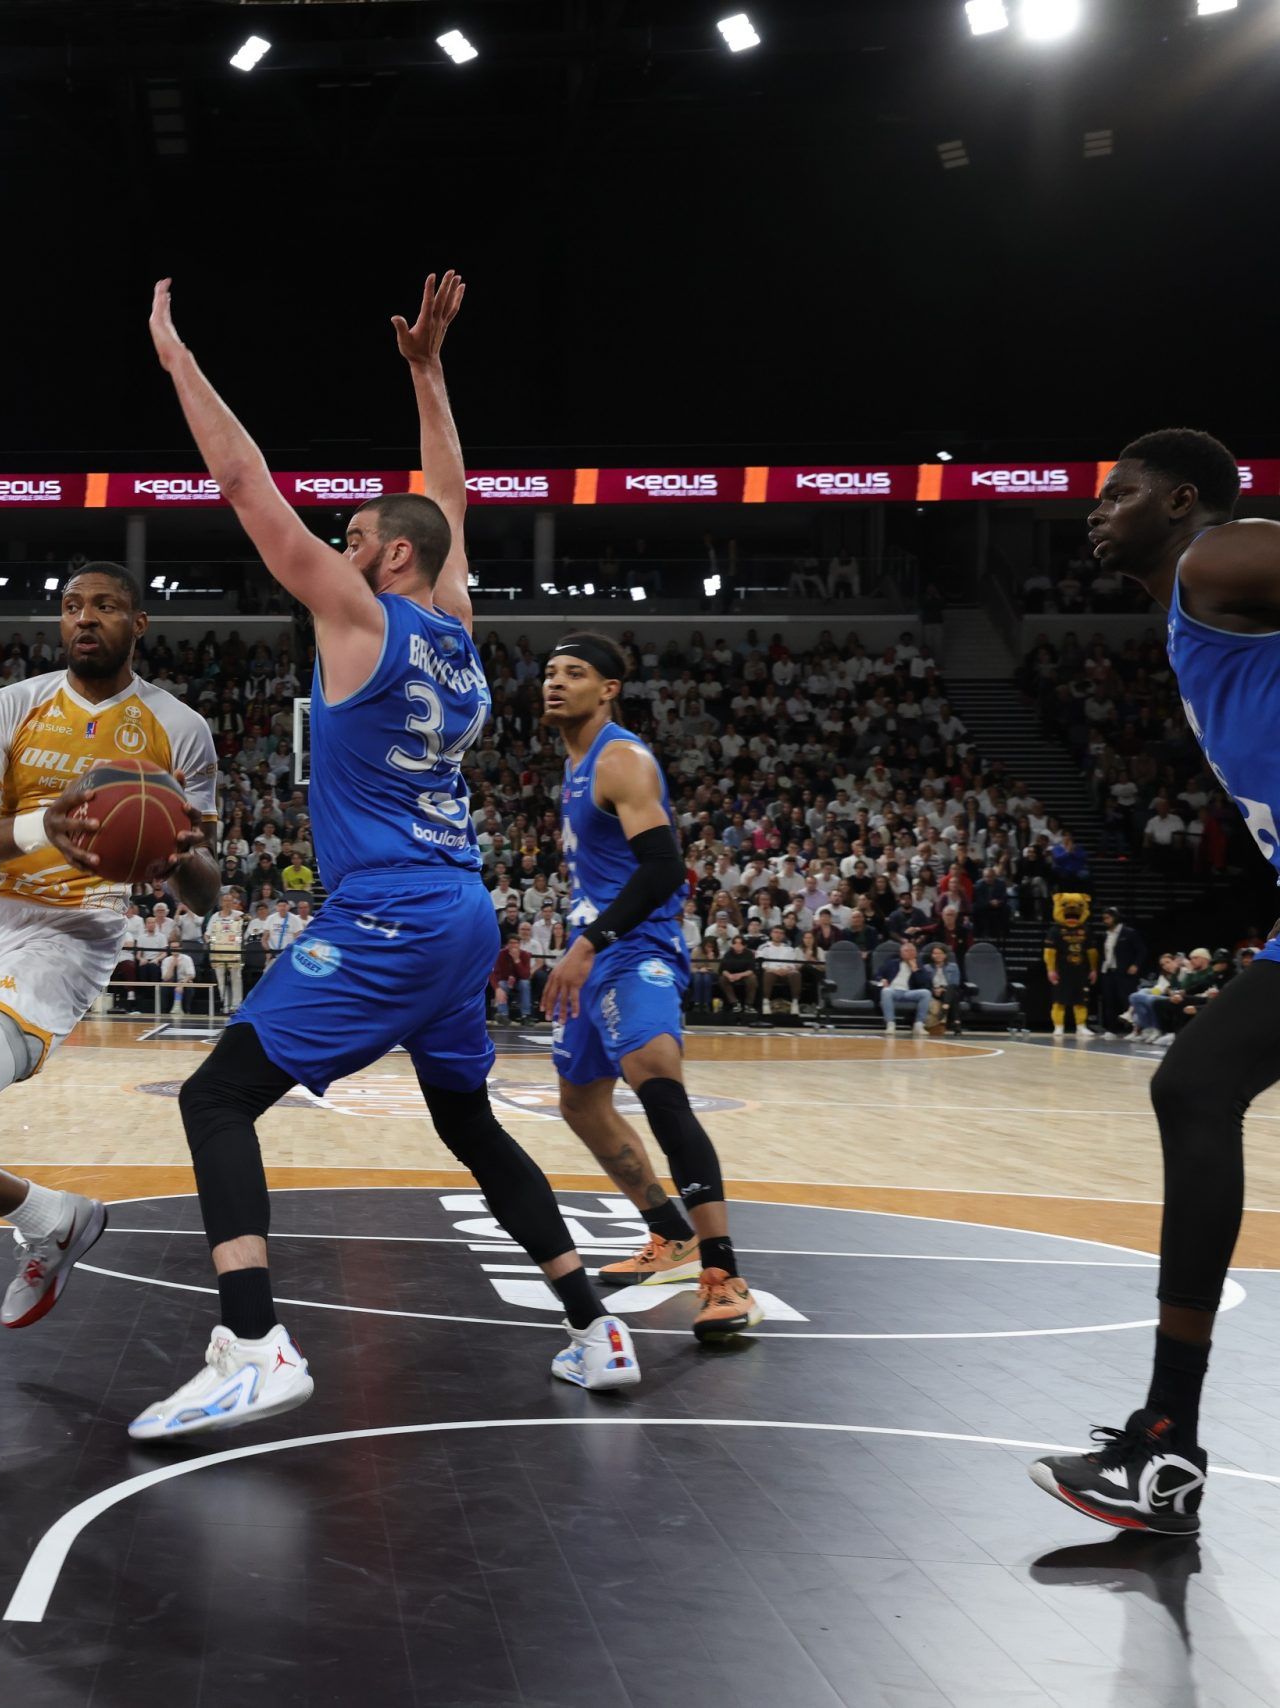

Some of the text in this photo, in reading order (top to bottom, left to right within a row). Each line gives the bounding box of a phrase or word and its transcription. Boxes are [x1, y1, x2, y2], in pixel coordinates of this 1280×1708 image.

[386, 680, 488, 775] 34
[19, 746, 113, 775] ORLÉ
[412, 822, 466, 850] boulang
